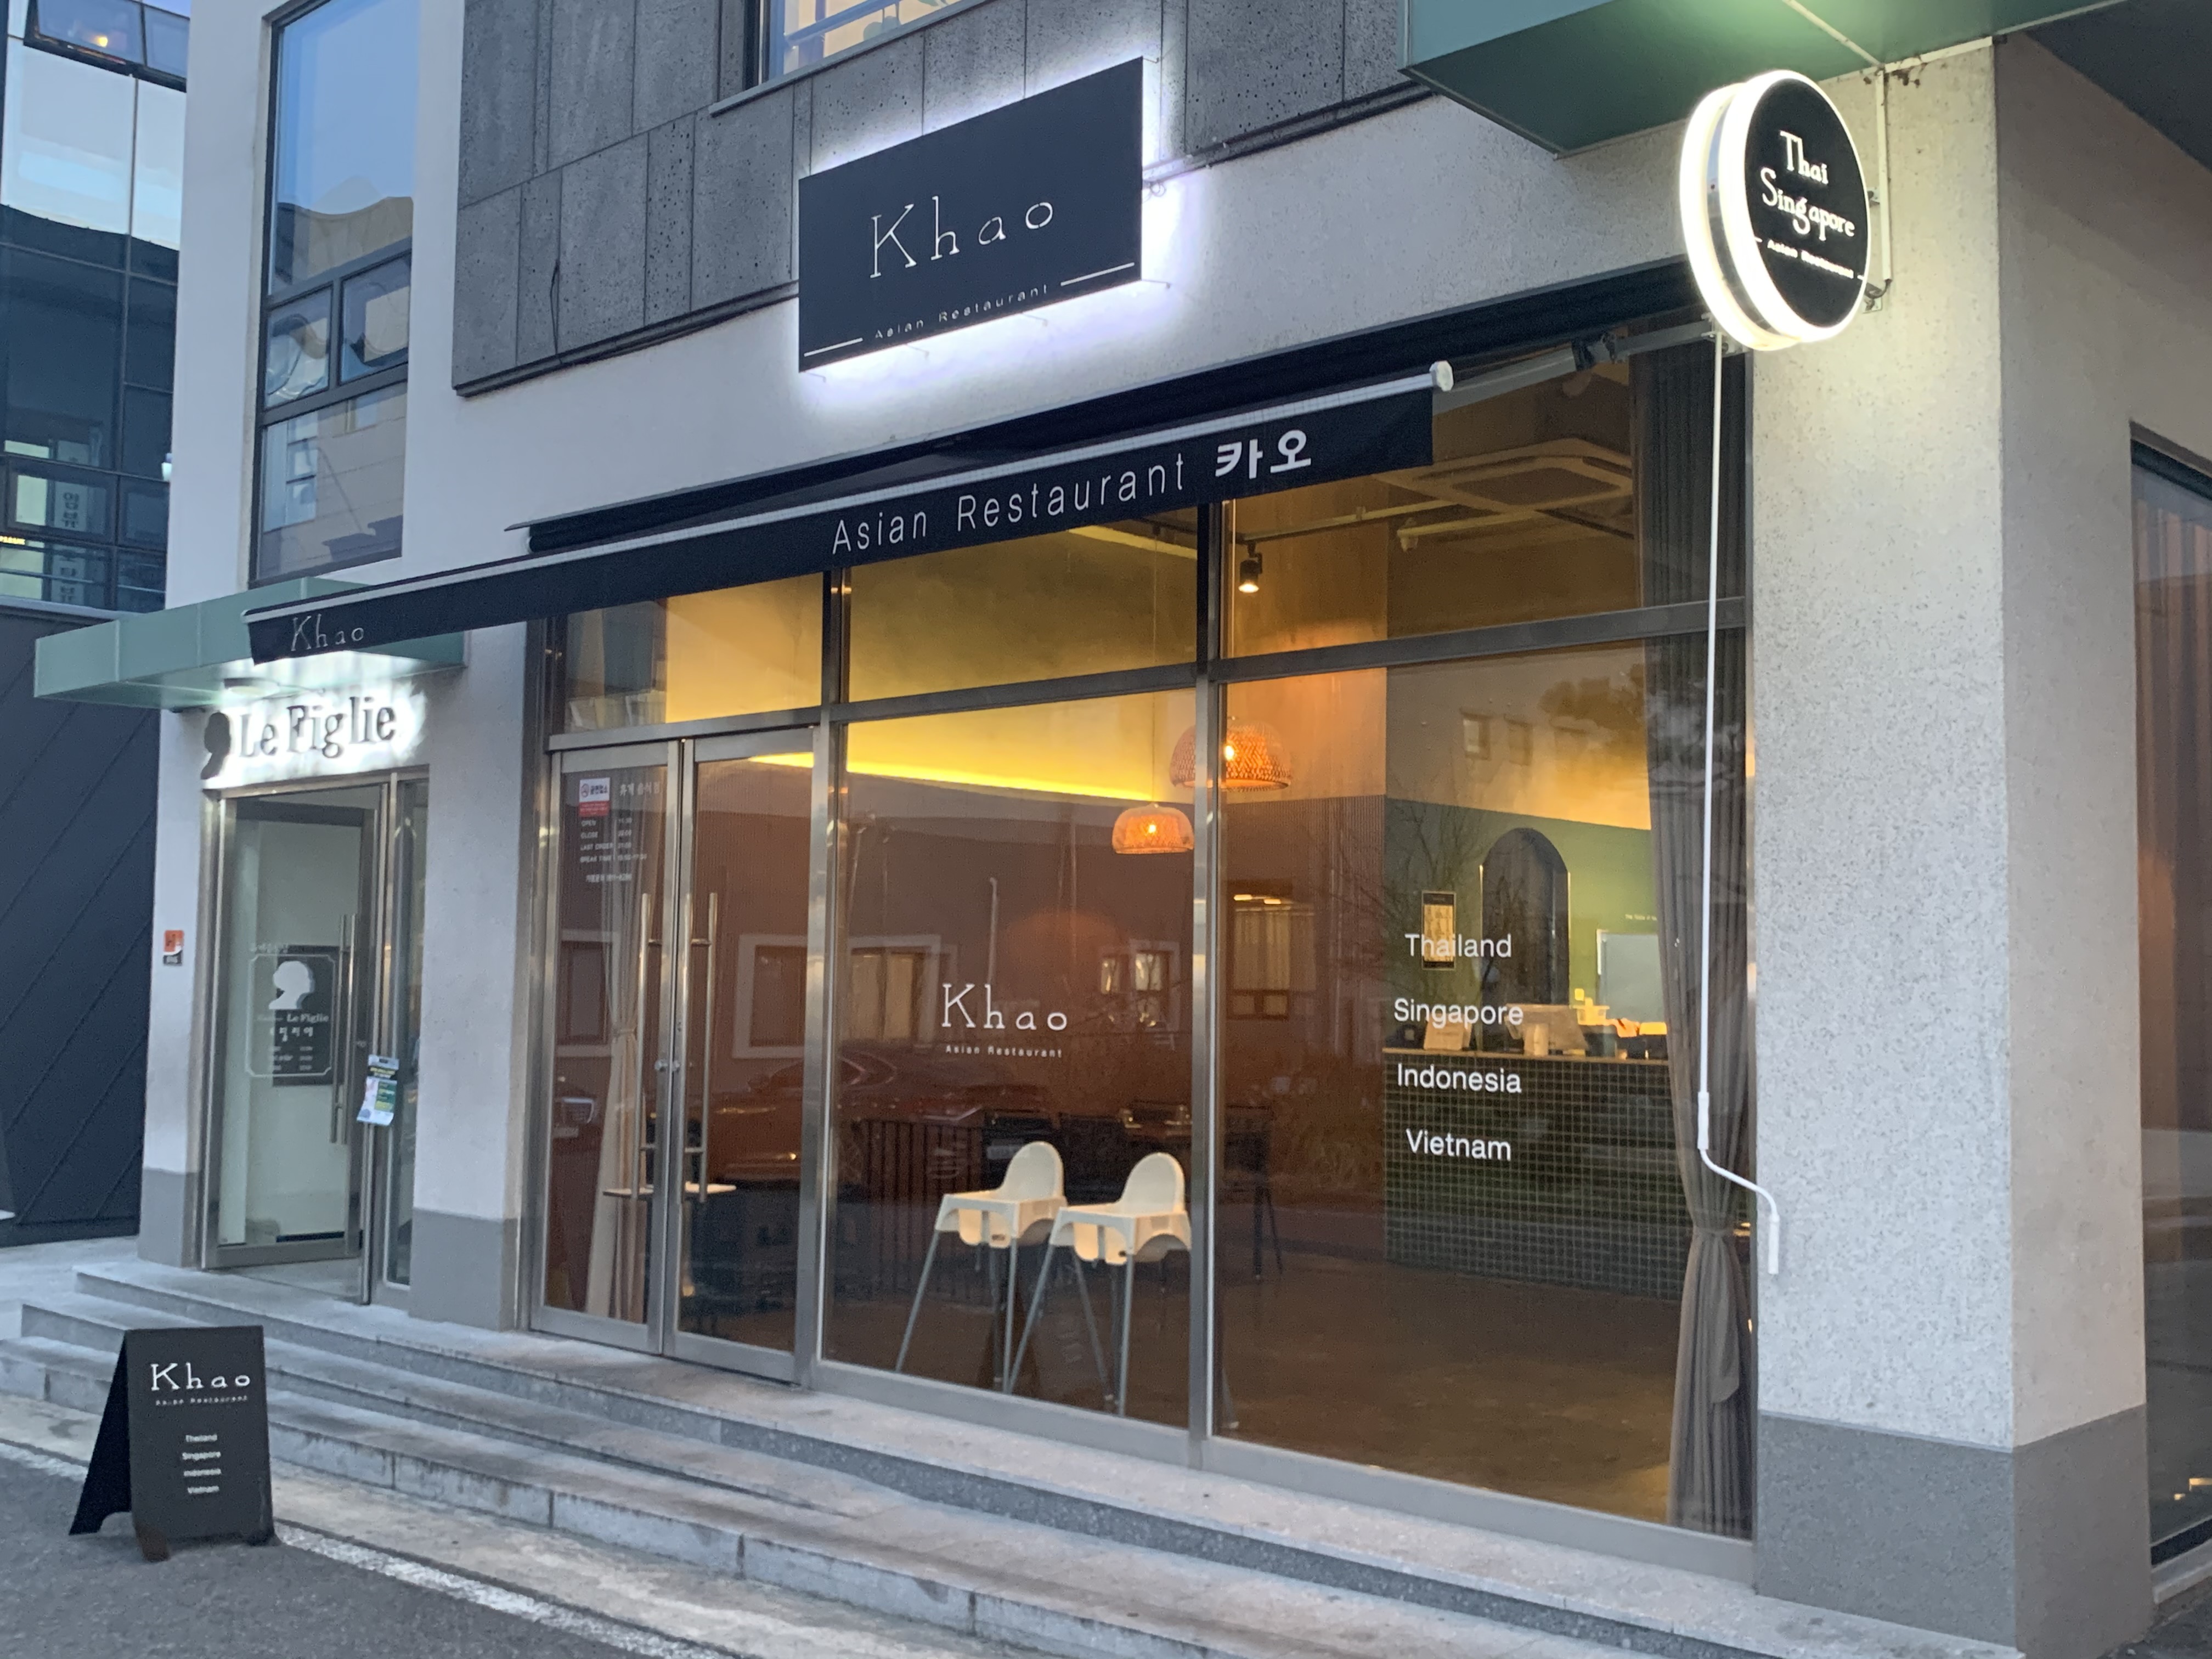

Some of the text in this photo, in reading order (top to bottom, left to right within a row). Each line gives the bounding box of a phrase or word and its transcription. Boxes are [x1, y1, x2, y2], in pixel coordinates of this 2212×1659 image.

[1780, 130, 1829, 185] Thai
[1760, 167, 1855, 241] Singapore
[870, 195, 1053, 279] Khao
[874, 284, 1047, 338] Asian Restaurant
[832, 429, 1312, 555] Asian Restaurant 카오
[290, 614, 364, 652] Khao
[239, 696, 397, 759] Le Figlie
[1404, 933, 1512, 958] Thailand
[941, 983, 1068, 1031] Khao
[1393, 997, 1524, 1029] Singapore
[945, 1045, 1063, 1058] Asian Restaurant
[1397, 1062, 1522, 1094] Indonesia
[1405, 1128, 1512, 1161] Vietnam
[150, 1362, 251, 1391] Khao
